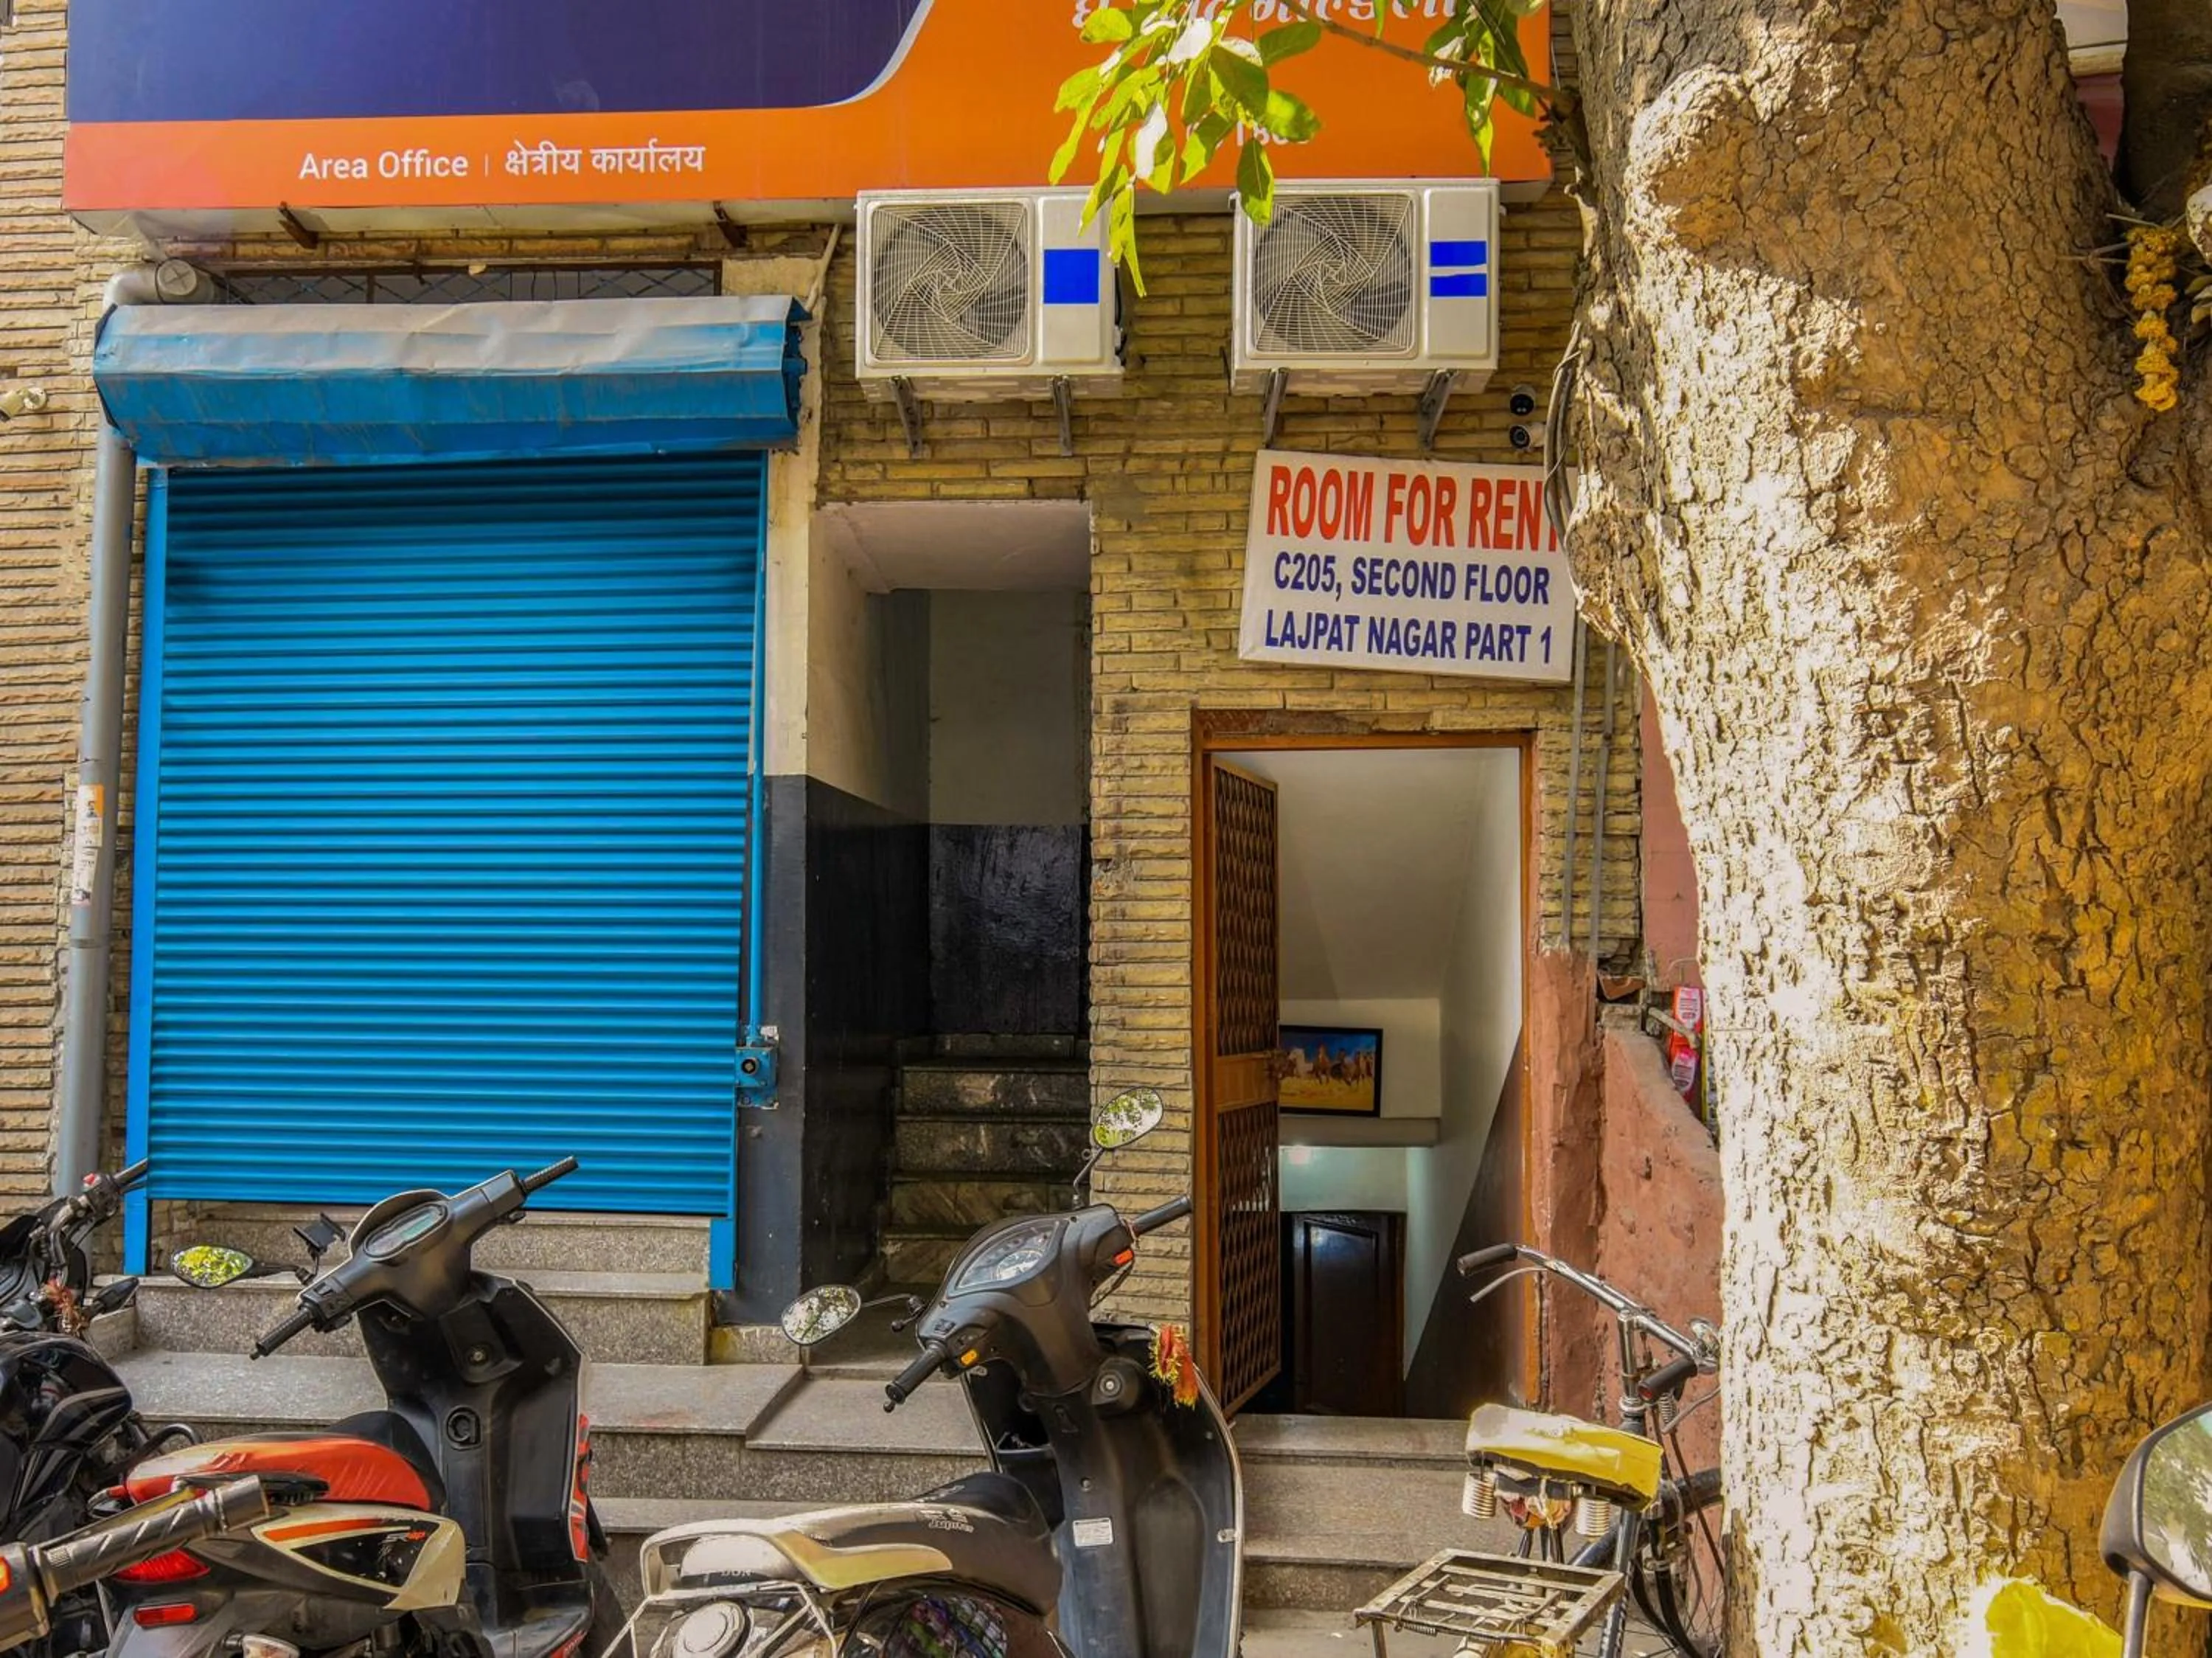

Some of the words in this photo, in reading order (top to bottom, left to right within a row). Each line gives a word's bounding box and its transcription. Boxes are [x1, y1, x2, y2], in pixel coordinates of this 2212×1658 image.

[299, 153, 367, 179] Area
[378, 150, 468, 178] Office
[505, 140, 582, 176] क्षेत्रीय
[590, 139, 706, 174] कार्यालय
[1267, 465, 1374, 542] ROOM
[1384, 473, 1457, 547] FOR
[1274, 552, 1342, 601] C205,
[1351, 555, 1456, 600] SECOND
[1464, 563, 1549, 605] FLOOR
[1265, 609, 1360, 652] LAJPAT
[1367, 616, 1457, 659] NAGAR
[1465, 622, 1531, 662] PART
[1540, 625, 1553, 664] 1
